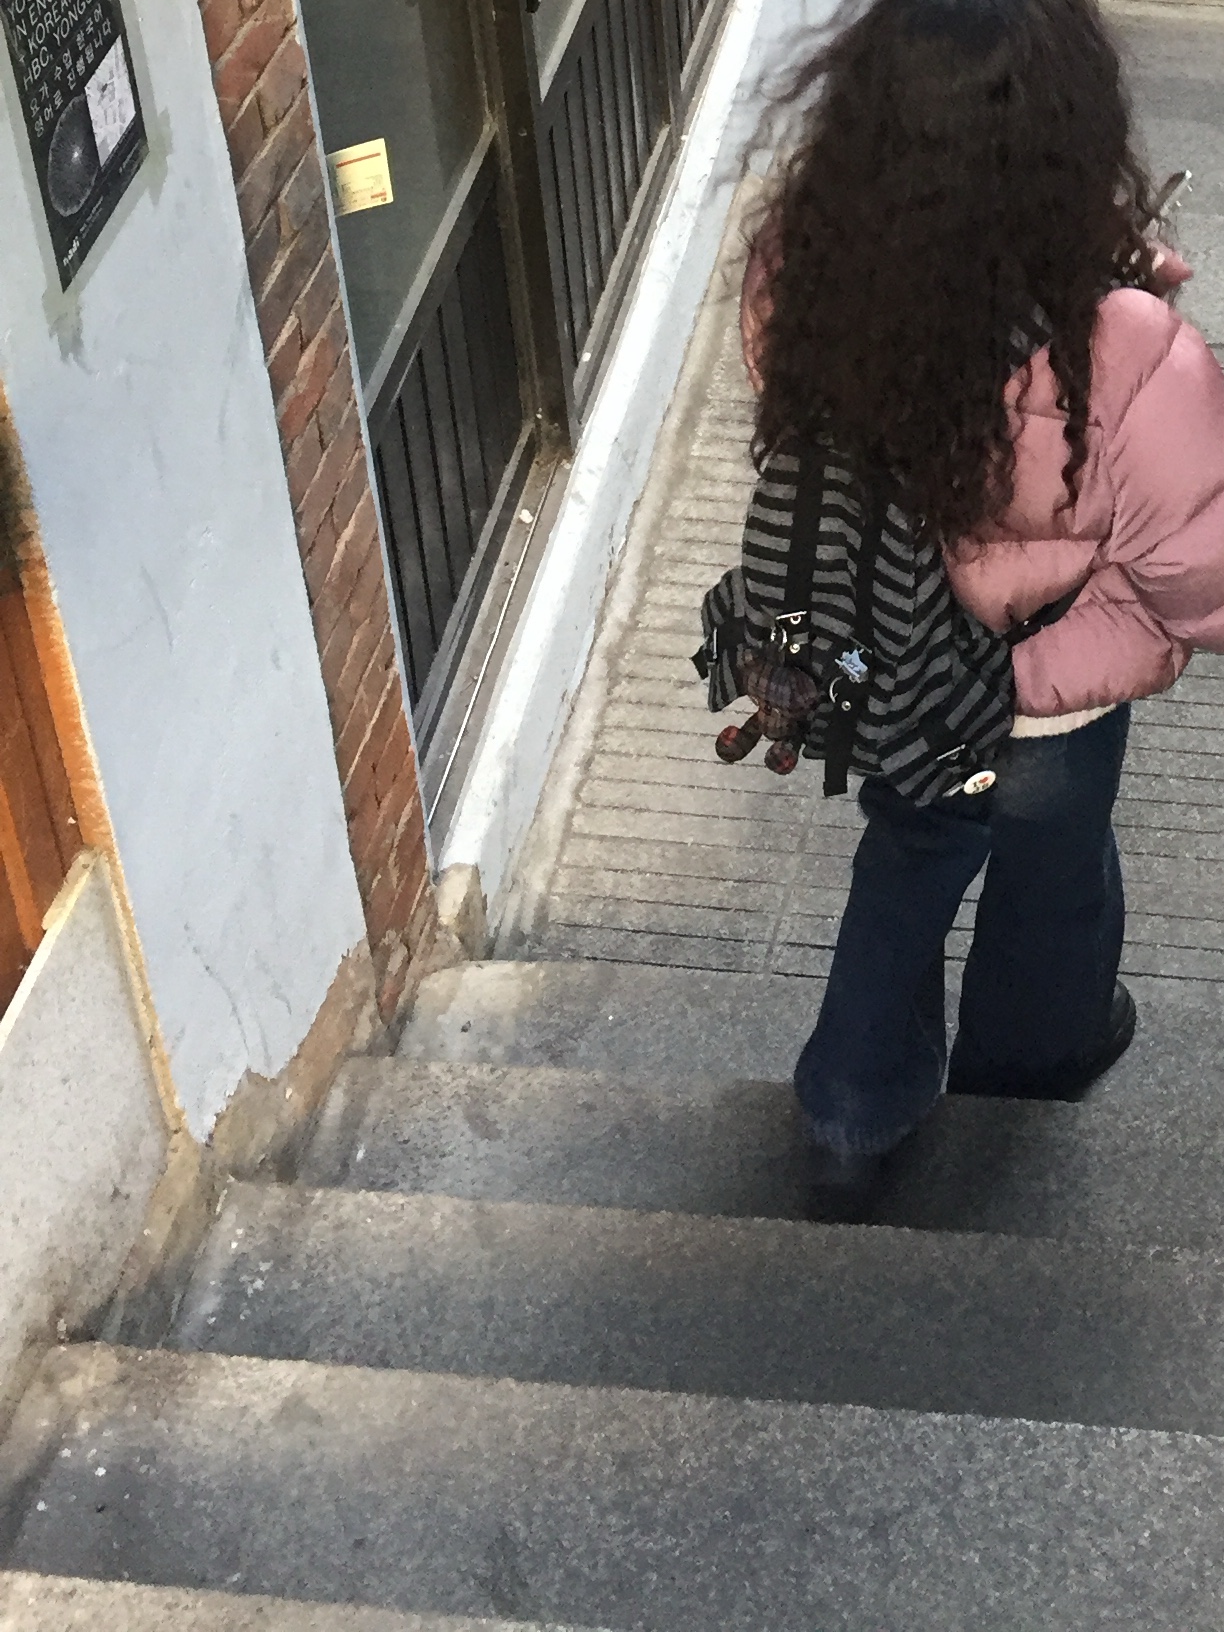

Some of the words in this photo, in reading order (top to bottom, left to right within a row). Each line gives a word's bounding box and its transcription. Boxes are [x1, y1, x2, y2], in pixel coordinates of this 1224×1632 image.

[13, 18, 27, 55] IN
[30, 82, 49, 118] 요가
[54, 48, 73, 81] 수업
[76, 3, 103, 51] 한국어
[34, 90, 63, 137] 영어로
